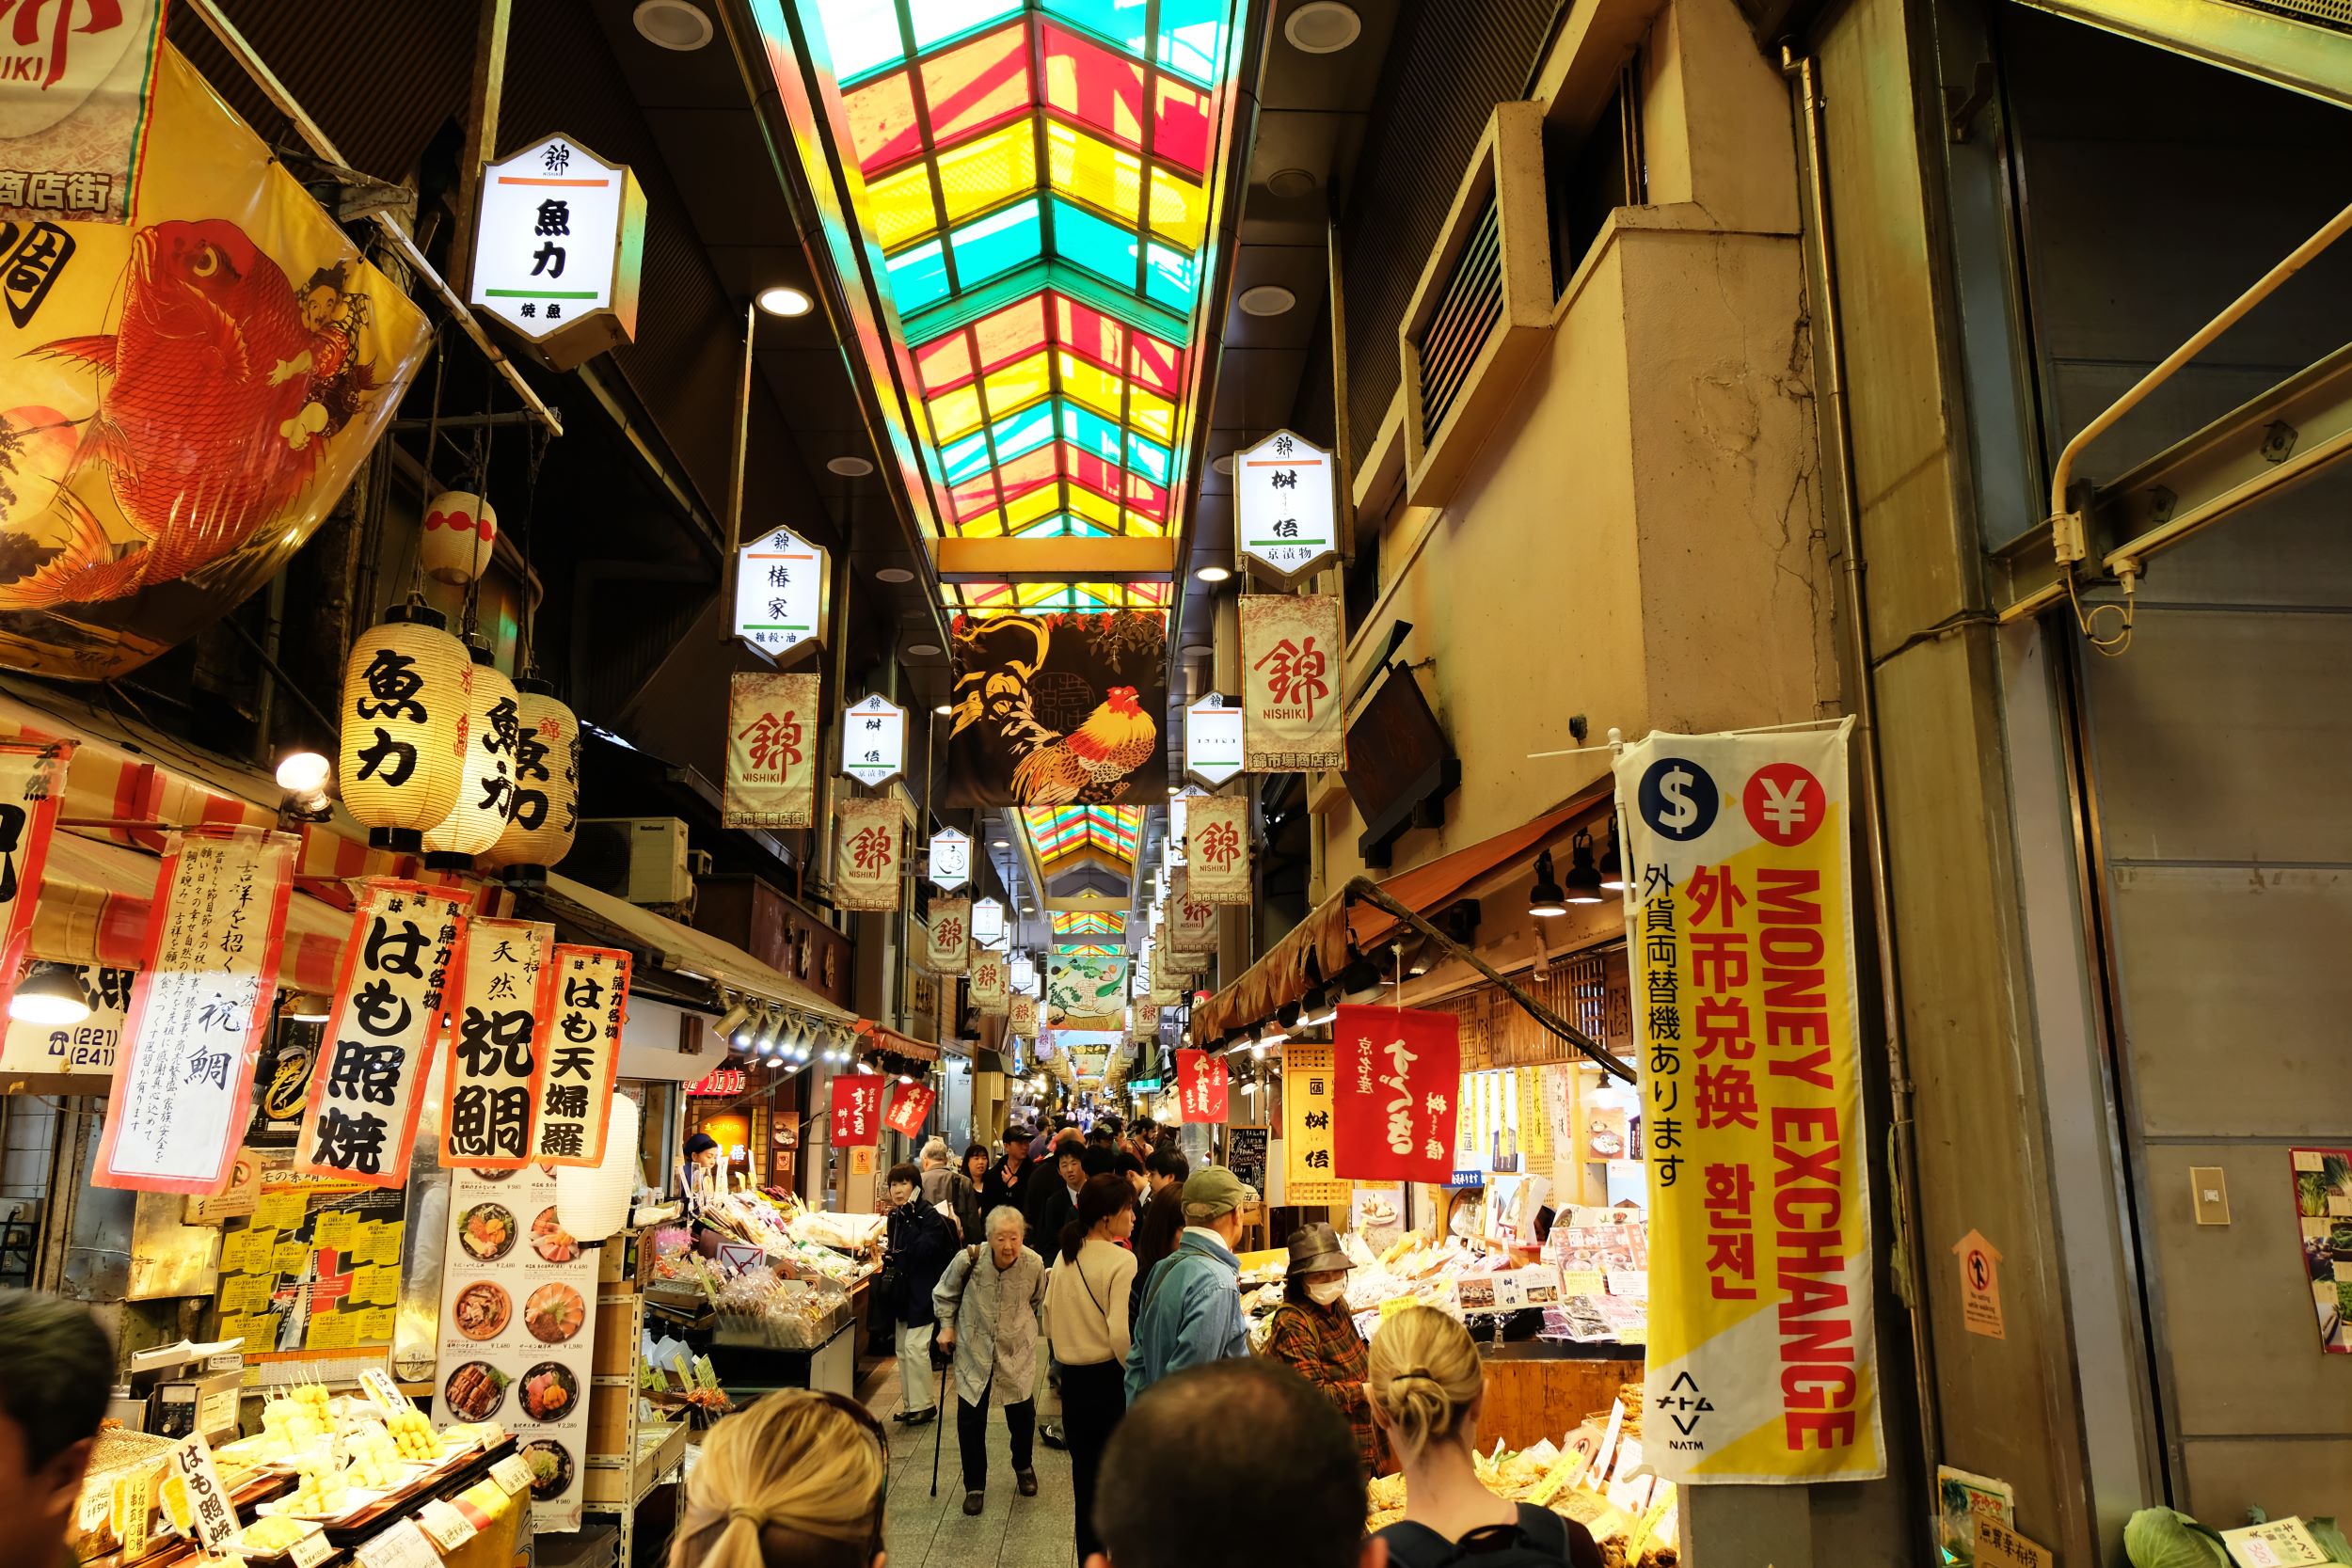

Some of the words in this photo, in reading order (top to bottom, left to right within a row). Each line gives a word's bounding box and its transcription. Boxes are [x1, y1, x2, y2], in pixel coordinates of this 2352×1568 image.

[540, 144, 570, 176] 錦
[530, 198, 570, 278] 魚力
[521, 303, 562, 319] 焼魚
[1272, 436, 1294, 459] 錦
[771, 532, 789, 552] 錦
[1267, 547, 1311, 560] 京漬物
[768, 565, 791, 620] 椿家
[1254, 637, 1329, 722] 錦
[357, 649, 428, 787] 魚力
[538, 717, 561, 741] 錦
[1263, 708, 1306, 720] NISHIKI
[739, 710, 803, 785] 錦
[1252, 752, 1340, 768] 錦市場商店街
[742, 772, 780, 784] NISHIKI
[729, 811, 804, 826] 錦市場商店街
[847, 825, 892, 881] 錦
[1195, 820, 1241, 874] 錦
[1200, 864, 1227, 873] NISHIKI
[932, 916, 963, 956] 錦
[487, 942, 518, 1001] 天然
[1686, 863, 1758, 1132] 外币兑换
[1756, 867, 1835, 1091] MONEY
[73, 1027, 118, 1047] (221)
[184, 991, 241, 1091] 祝鯛
[311, 917, 432, 1175] はも照焼
[1643, 863, 1685, 1187] 外貨両替機あります
[70, 1046, 116, 1067] (241)
[450, 1006, 535, 1159] 祝鯛
[540, 976, 605, 1157] はも天婦羅
[851, 1087, 866, 1135] すぐき
[1703, 1162, 1757, 1302] 환전
[1770, 1105, 1855, 1451] EXCHANGE
[1669, 1440, 1704, 1450] NATM
